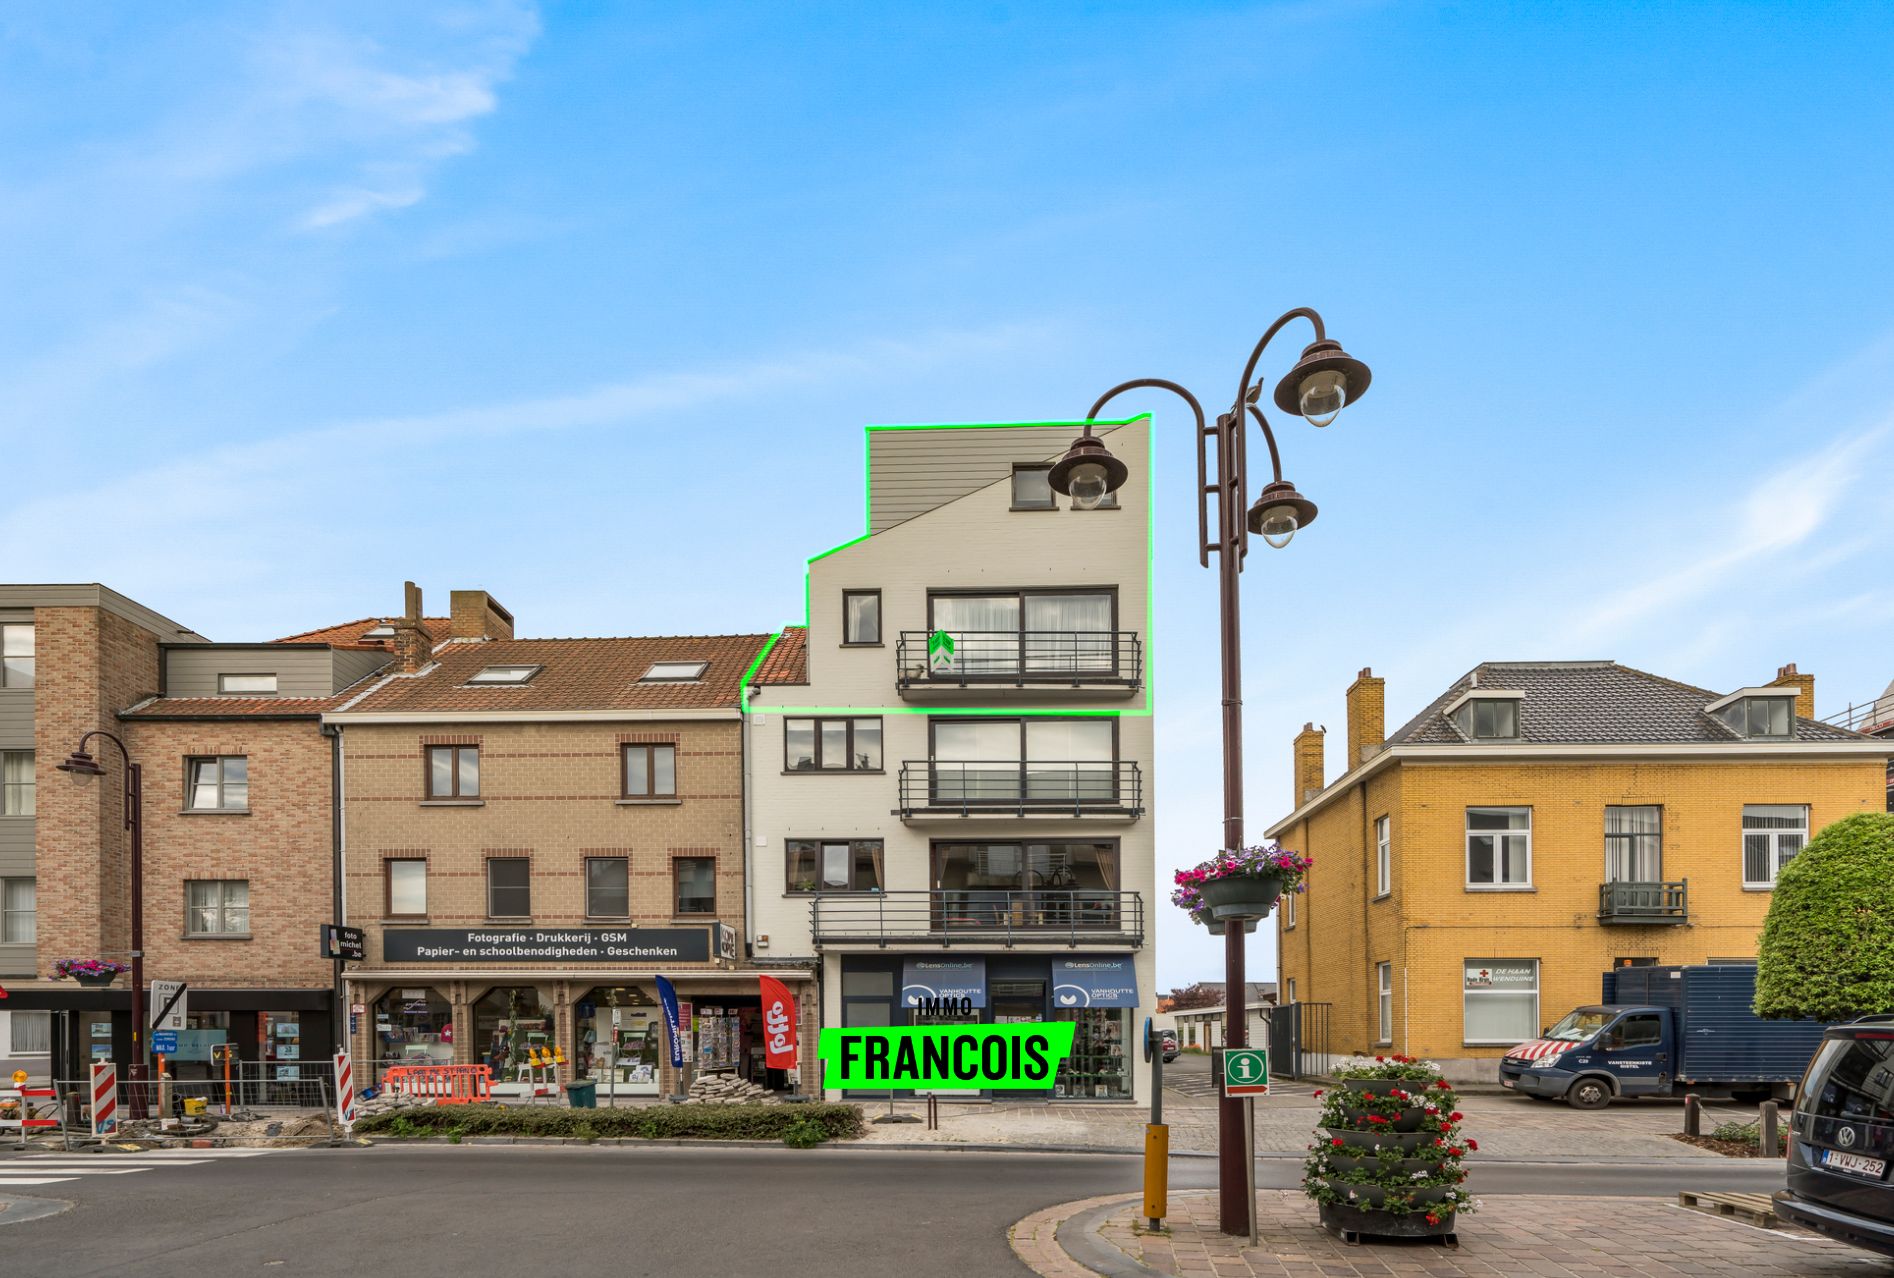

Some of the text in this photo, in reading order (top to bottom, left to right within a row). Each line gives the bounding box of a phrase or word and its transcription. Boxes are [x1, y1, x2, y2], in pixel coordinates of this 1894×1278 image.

[344, 931, 357, 940] foto
[467, 933, 627, 944] Fotografie Drukkerij GSM
[340, 941, 362, 949] michel
[417, 946, 678, 957] Papier- en schoolbenodigheden Geschenken
[766, 1001, 794, 1055] lotto
[1829, 1152, 1884, 1174] 1-VWJ-252
